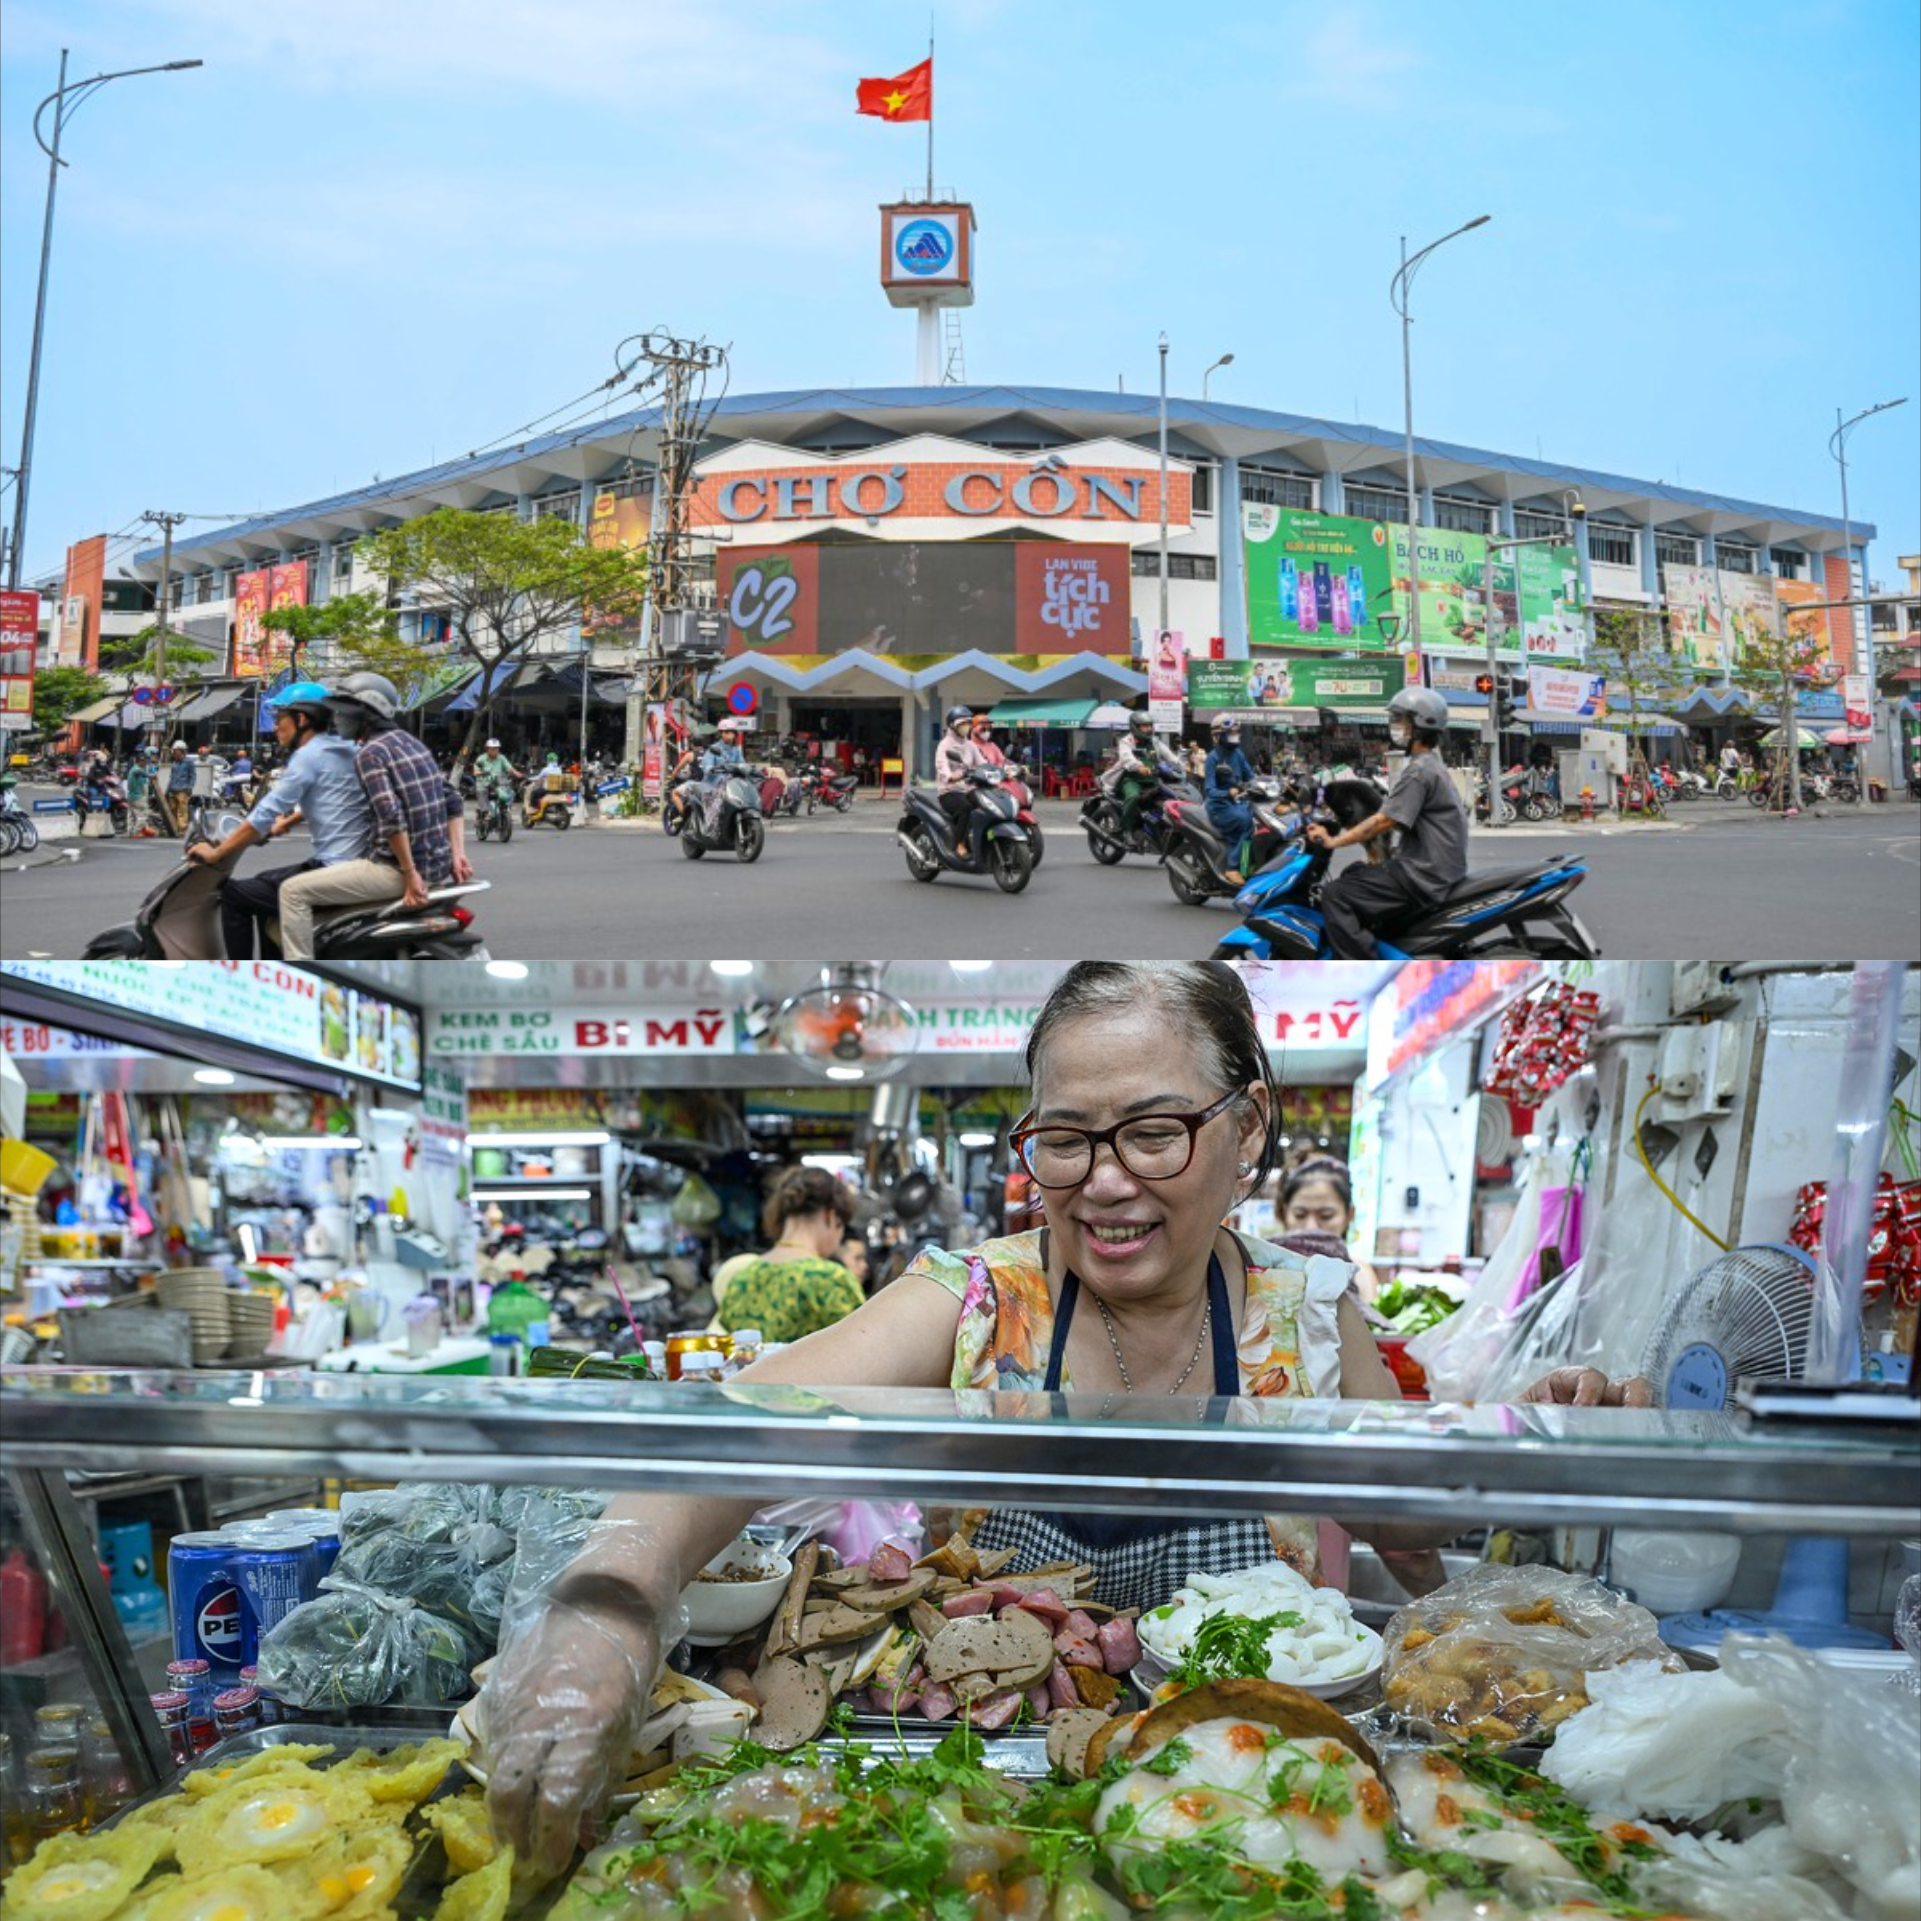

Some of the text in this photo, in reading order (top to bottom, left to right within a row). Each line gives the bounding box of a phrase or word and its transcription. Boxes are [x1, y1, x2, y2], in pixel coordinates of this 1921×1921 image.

[717, 465, 906, 526] CHỢ
[1045, 558, 1069, 570] LAN
[1396, 543, 1439, 561] BCH
[730, 568, 796, 638] C2
[1043, 570, 1109, 605] tích
[1041, 600, 1100, 638] cực
[441, 1010, 552, 1028] KEM BƠ
[646, 1008, 725, 1046] MỸ
[204, 1618, 240, 1635] PE
